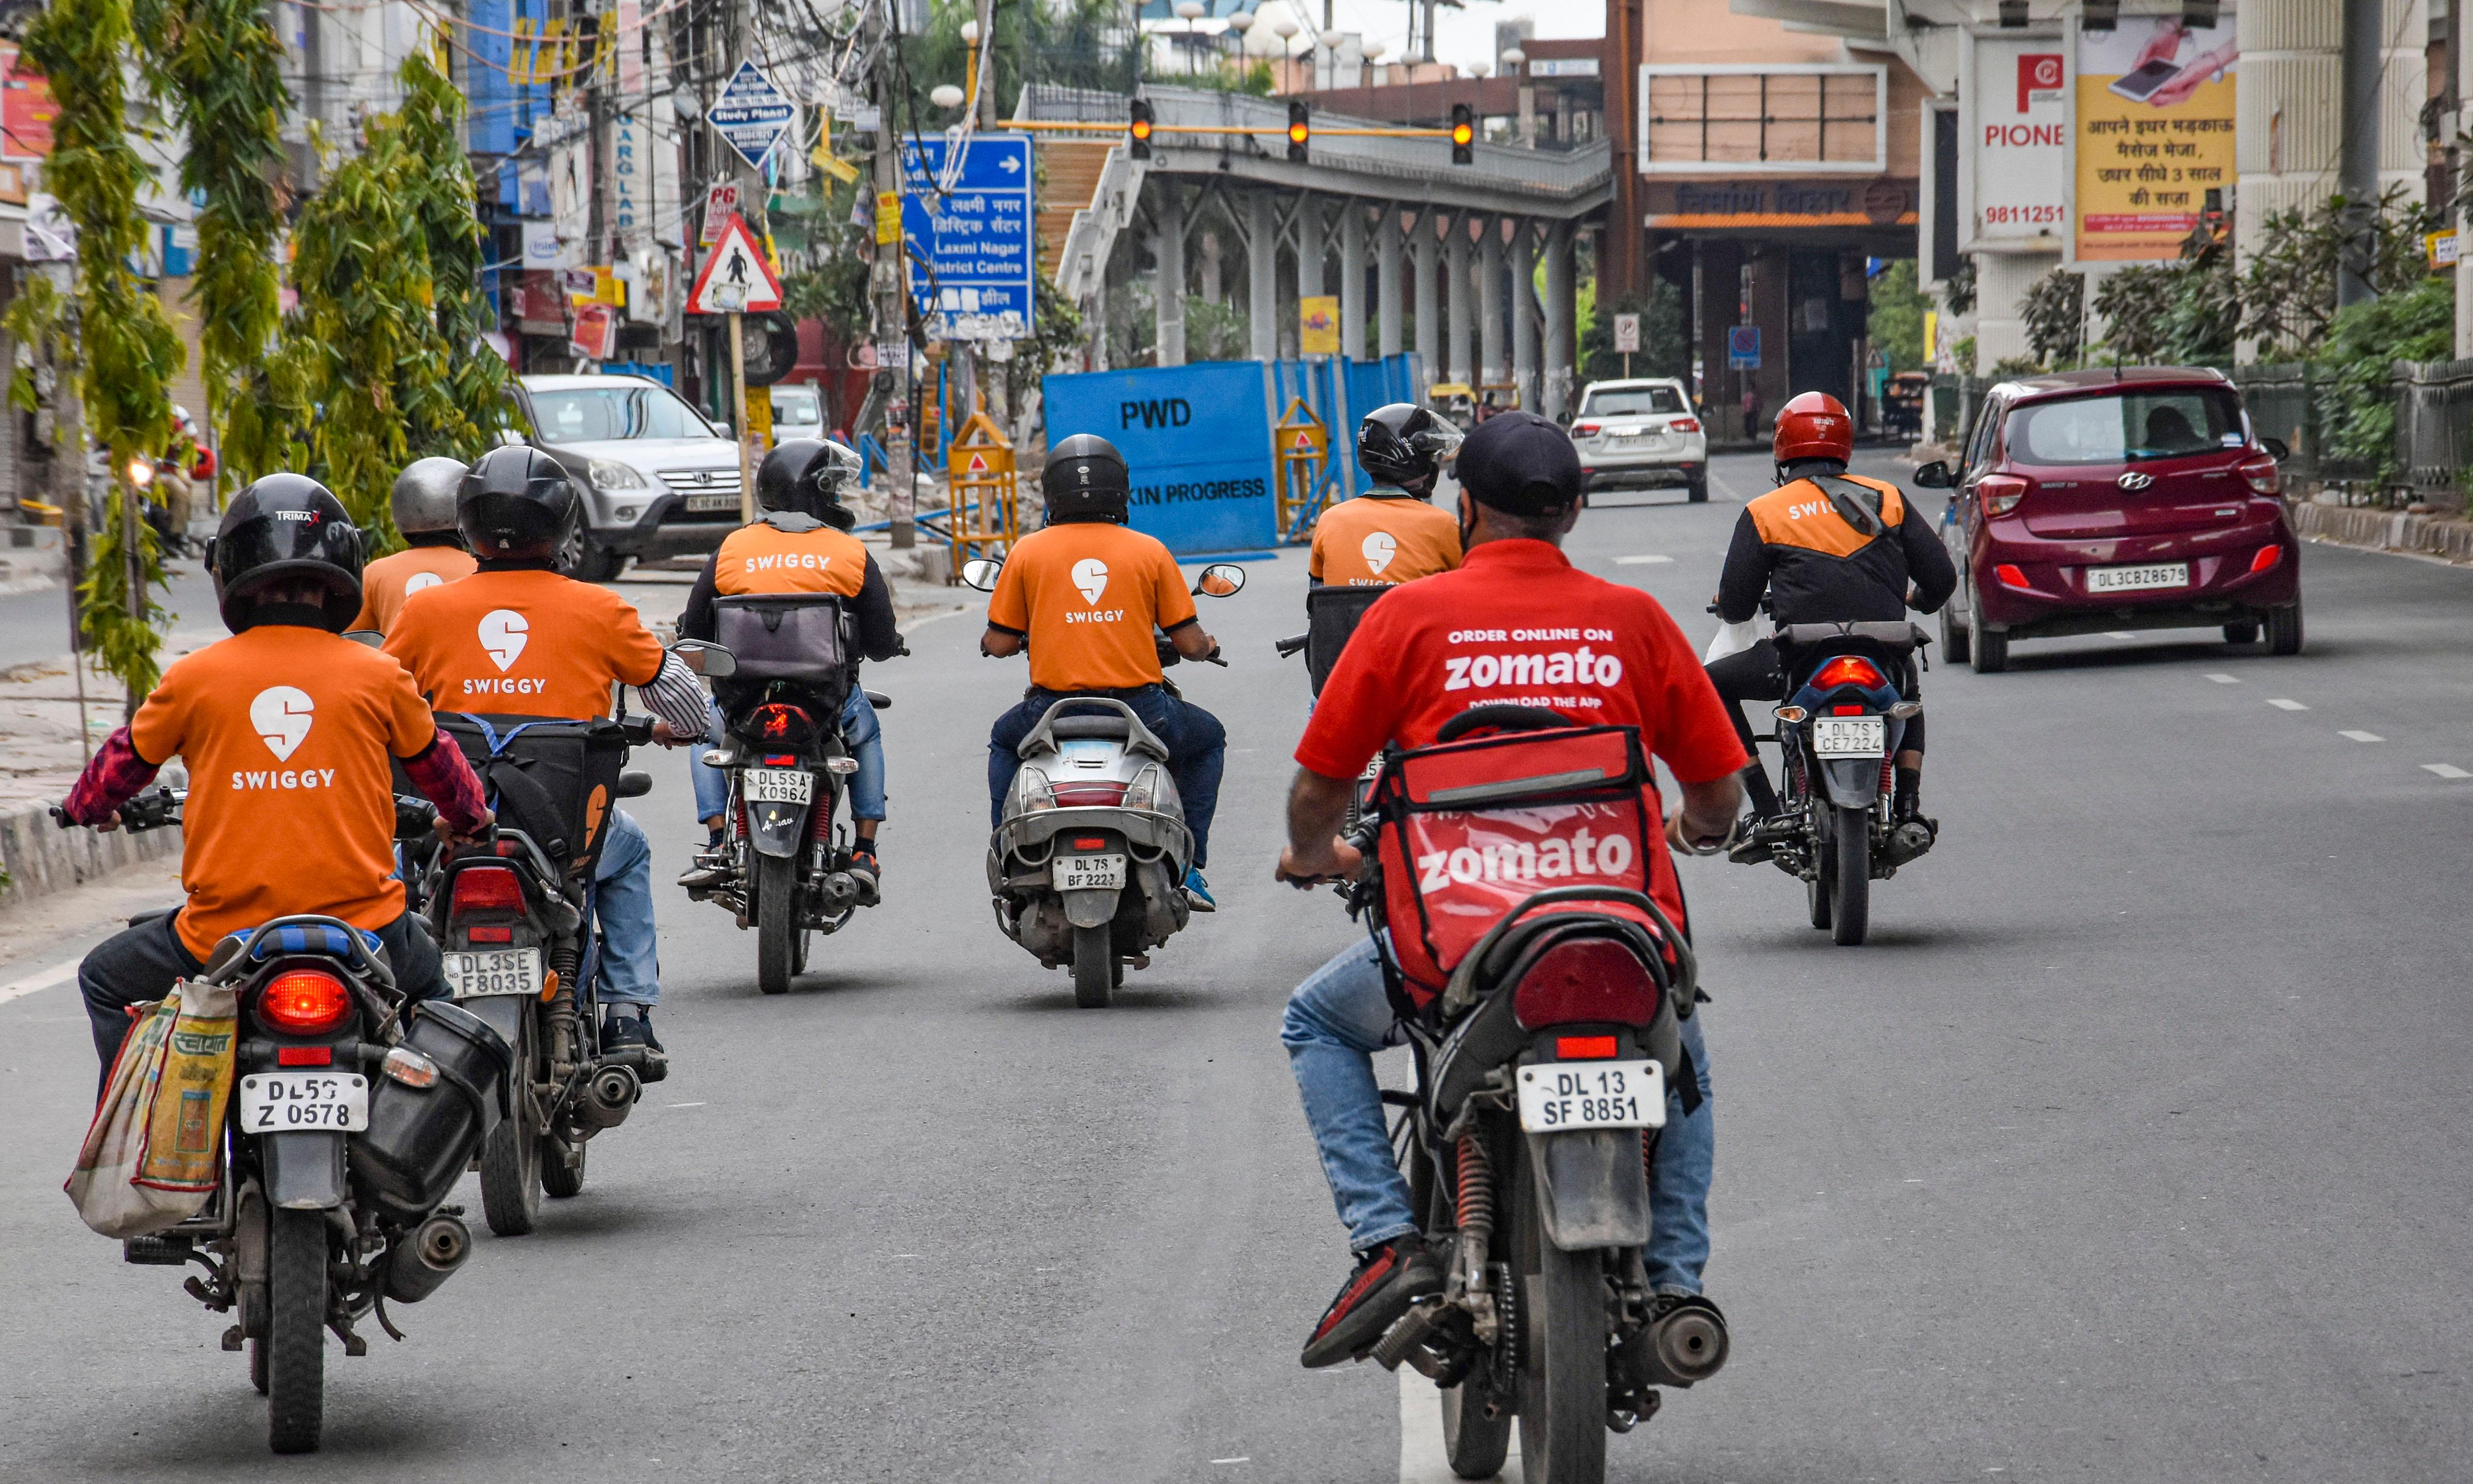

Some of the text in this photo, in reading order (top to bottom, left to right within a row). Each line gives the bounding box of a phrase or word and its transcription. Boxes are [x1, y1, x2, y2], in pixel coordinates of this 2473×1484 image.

[716, 107, 788, 122] Study Planet
[2089, 116, 2130, 134] आपने
[2173, 168, 2182, 181] 3
[2188, 166, 2221, 181] साल
[710, 187, 736, 204] PG
[951, 194, 1021, 213] लक्ष्मी नगर
[2129, 187, 2149, 205] की
[1986, 207, 2064, 224] 9811251
[935, 241, 1022, 257] Laxmi Nagar
[977, 259, 1023, 274] Centre
[1121, 398, 1191, 429] PWD
[1166, 478, 1266, 503] PROGRESS
[275, 510, 321, 527] TRIMAX
[745, 554, 831, 574] SWIGGY
[2098, 568, 2186, 587] DL3CBZ8679
[1065, 609, 1124, 624] SWIGGY
[1447, 628, 1614, 644] ORDER ONLINE ON
[1444, 645, 1623, 691] zomato
[463, 678, 546, 695] SWIGGY
[1552, 696, 1576, 708] THE
[232, 769, 335, 790] SWIGGY
[759, 771, 806, 788] DL5SA
[1075, 859, 1090, 871] DL
[1417, 826, 1633, 895] zomato
[1068, 874, 1083, 886] BF
[461, 952, 529, 974] DL3SE
[462, 972, 531, 995] F8035
[1557, 1071, 1626, 1096] DL 13
[258, 1103, 349, 1126] Z 0578
[1543, 1096, 1638, 1125] SF 8851
